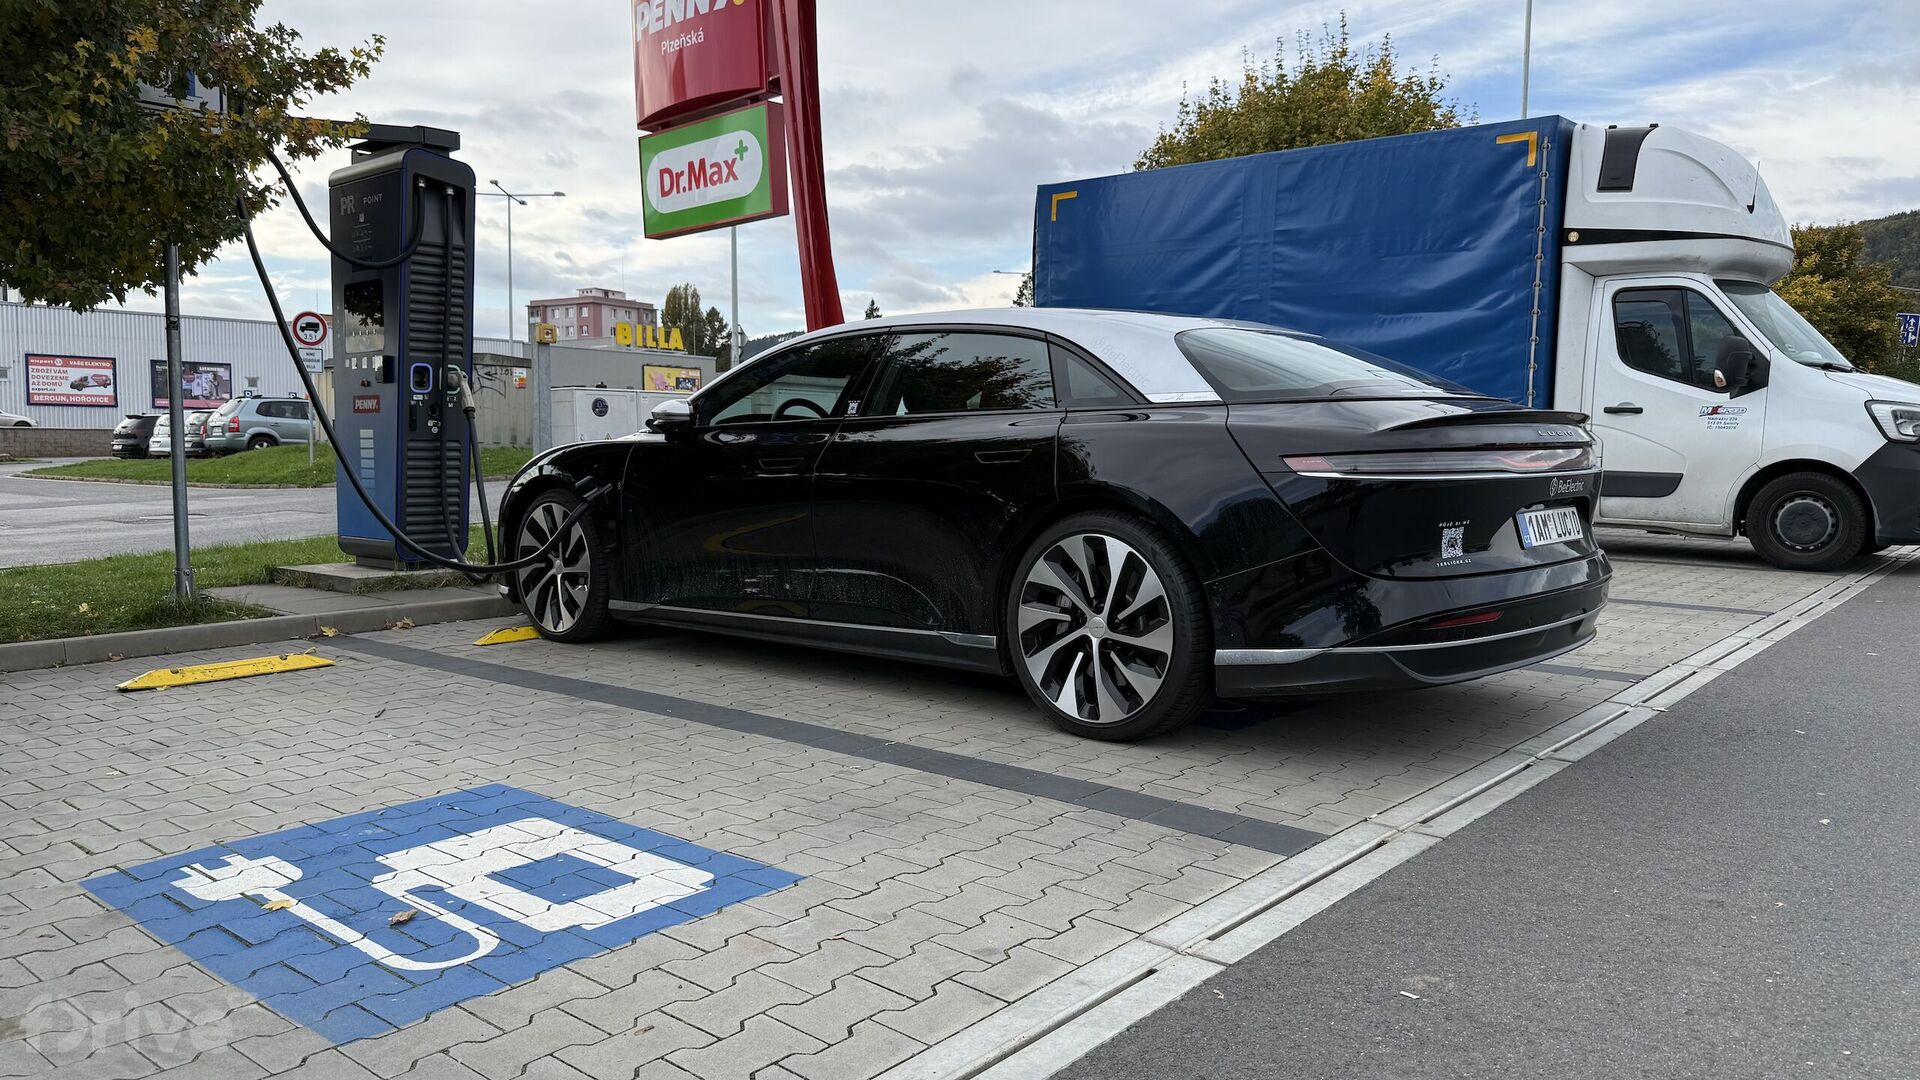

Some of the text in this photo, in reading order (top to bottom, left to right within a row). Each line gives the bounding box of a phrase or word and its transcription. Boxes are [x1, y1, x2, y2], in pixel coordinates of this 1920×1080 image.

[661, 28, 704, 55] Plzeňská
[615, 321, 685, 351] BILLA
[70, 395, 109, 403] HOŘOVICE
[1558, 479, 1584, 494] BeElectric
[1552, 510, 1581, 538] LUCID
